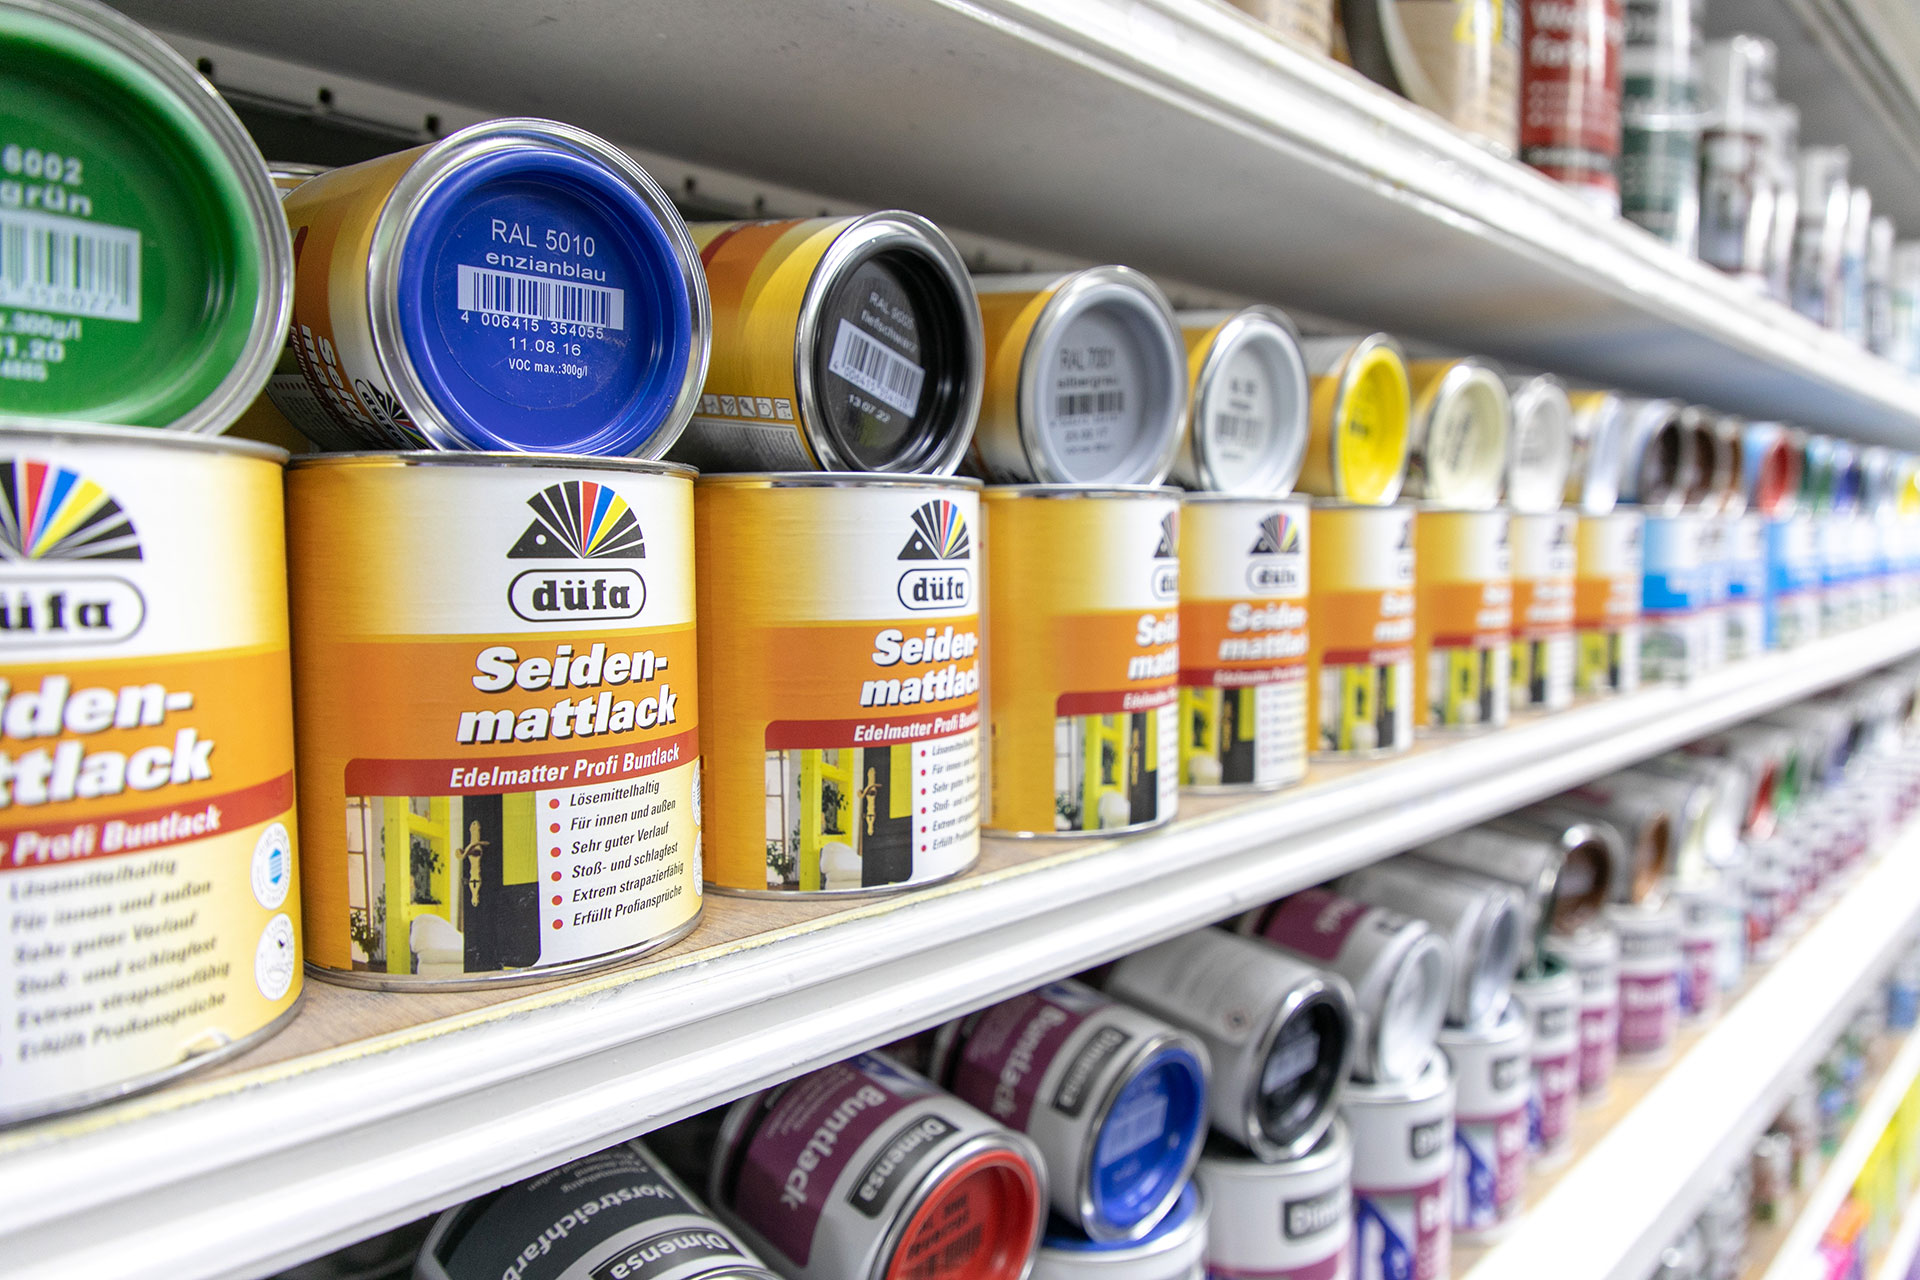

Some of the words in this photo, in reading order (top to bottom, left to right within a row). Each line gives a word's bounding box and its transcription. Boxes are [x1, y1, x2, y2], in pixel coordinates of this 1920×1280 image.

[3, 143, 83, 186] 6002
[491, 218, 538, 249] RAL
[545, 228, 596, 258] 5010
[485, 251, 606, 282] enzianblau
[460, 310, 470, 324] 4
[481, 312, 540, 332] 006415
[550, 321, 604, 340] 354055
[508, 336, 582, 357] 11.08.16
[508, 357, 531, 371] VOC
[534, 361, 588, 379] max.:300g/l
[532, 579, 631, 611] düfa
[913, 576, 964, 602] düfa
[471, 642, 668, 693] Seiden-
[456, 683, 678, 745] mattlack
[853, 721, 932, 742] Edelmatter
[933, 716, 959, 735] Profi
[450, 764, 568, 789] Edelmatter
[573, 754, 619, 780] Profi
[623, 743, 680, 772] Buntlack
[569, 780, 660, 807] Lösemittelhaltig
[570, 817, 591, 831] Für
[595, 812, 628, 828] innen
[630, 804, 649, 820] und
[651, 798, 676, 816] außen
[13, 823, 97, 866] Profi
[101, 803, 222, 853] Buntlack
[571, 839, 602, 855] Sehr
[604, 833, 636, 852] guter
[637, 821, 670, 842] Verlauf
[571, 862, 607, 879] Stoß-
[610, 854, 632, 871] und
[633, 841, 679, 866] schlagfest
[572, 886, 616, 903] Extrem
[619, 861, 684, 893] strapazierfähig
[572, 908, 612, 927] Erfüllt
[614, 885, 683, 918] Profiansprüche
[779, 1084, 887, 1211] Buntlack
[858, 1117, 948, 1202] Dimensa
[610, 1233, 730, 1280] Dimensa
